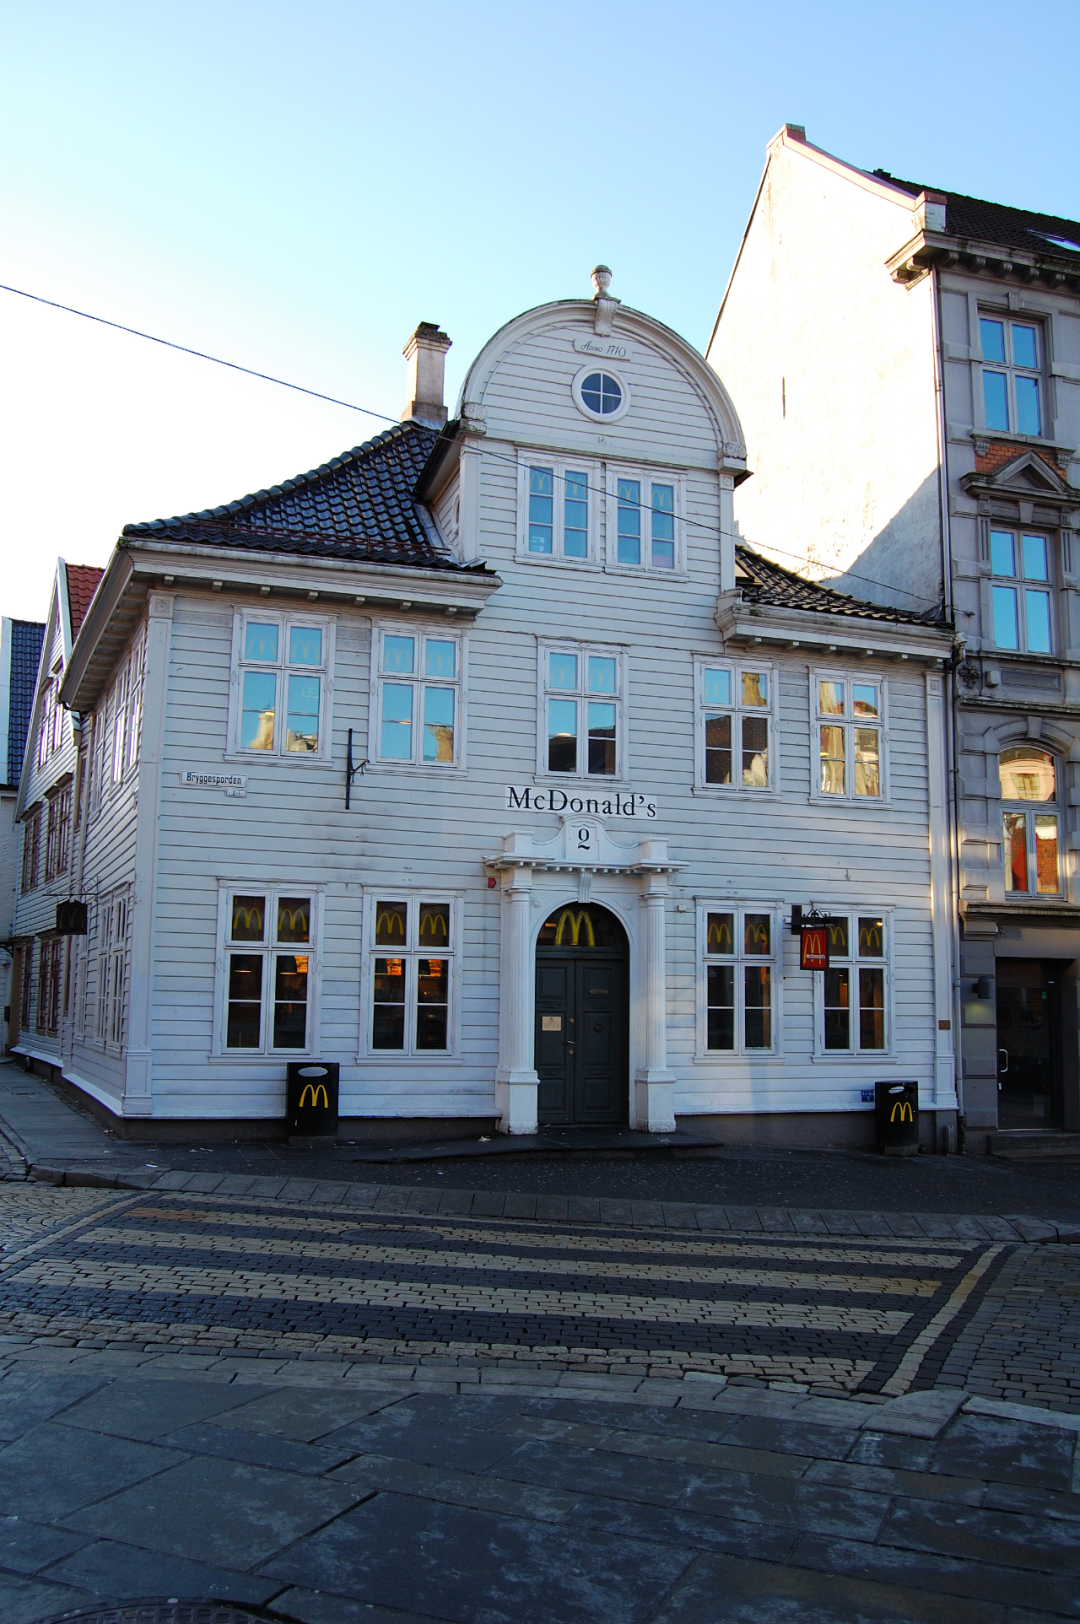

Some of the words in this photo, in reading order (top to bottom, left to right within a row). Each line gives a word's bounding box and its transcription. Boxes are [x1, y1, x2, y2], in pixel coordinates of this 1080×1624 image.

[580, 340, 603, 353] Anno
[606, 345, 627, 358] 1710
[186, 772, 242, 785] Bryggesporden
[507, 786, 656, 818] McDonald's
